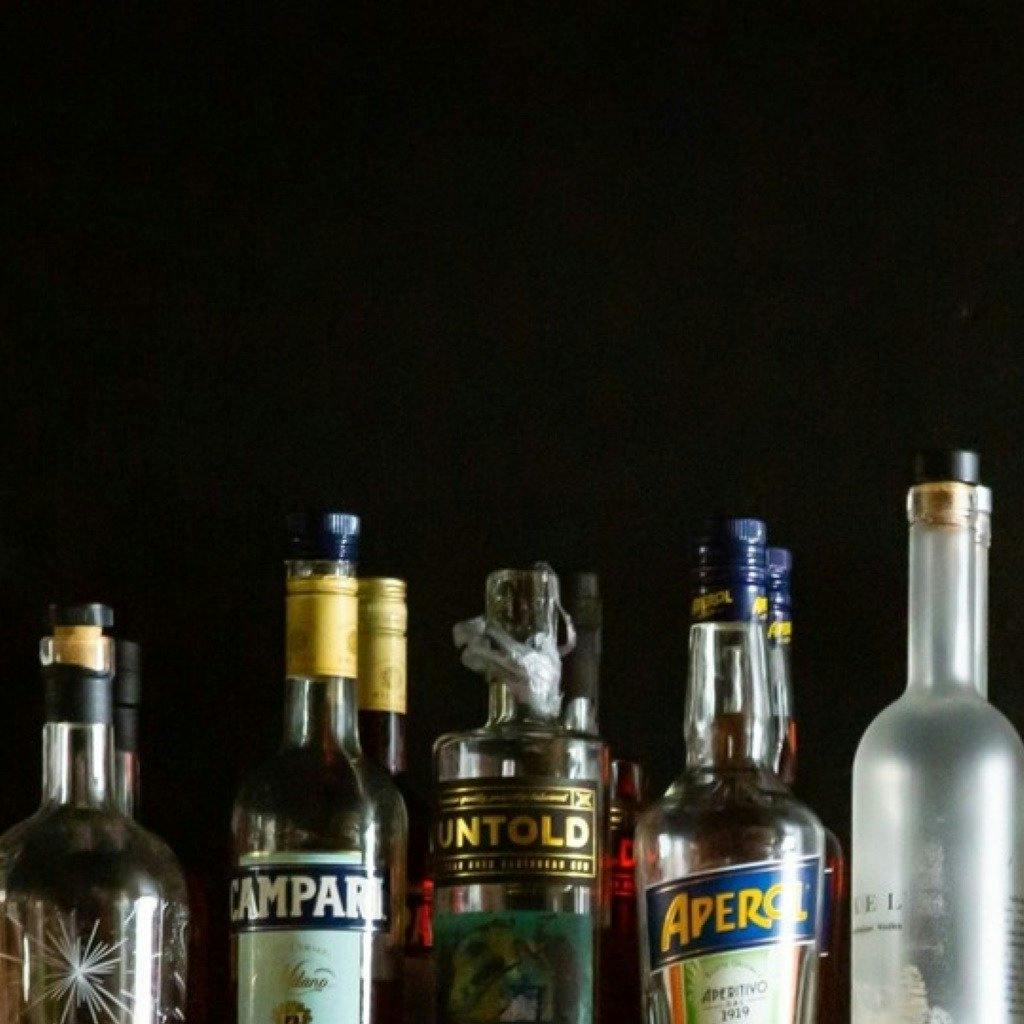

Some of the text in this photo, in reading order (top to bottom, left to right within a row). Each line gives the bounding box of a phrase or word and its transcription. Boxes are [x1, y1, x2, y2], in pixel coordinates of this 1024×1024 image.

[439, 816, 591, 848] UNTOLD
[660, 882, 808, 953] APEROL
[722, 1006, 750, 1022] 1919
